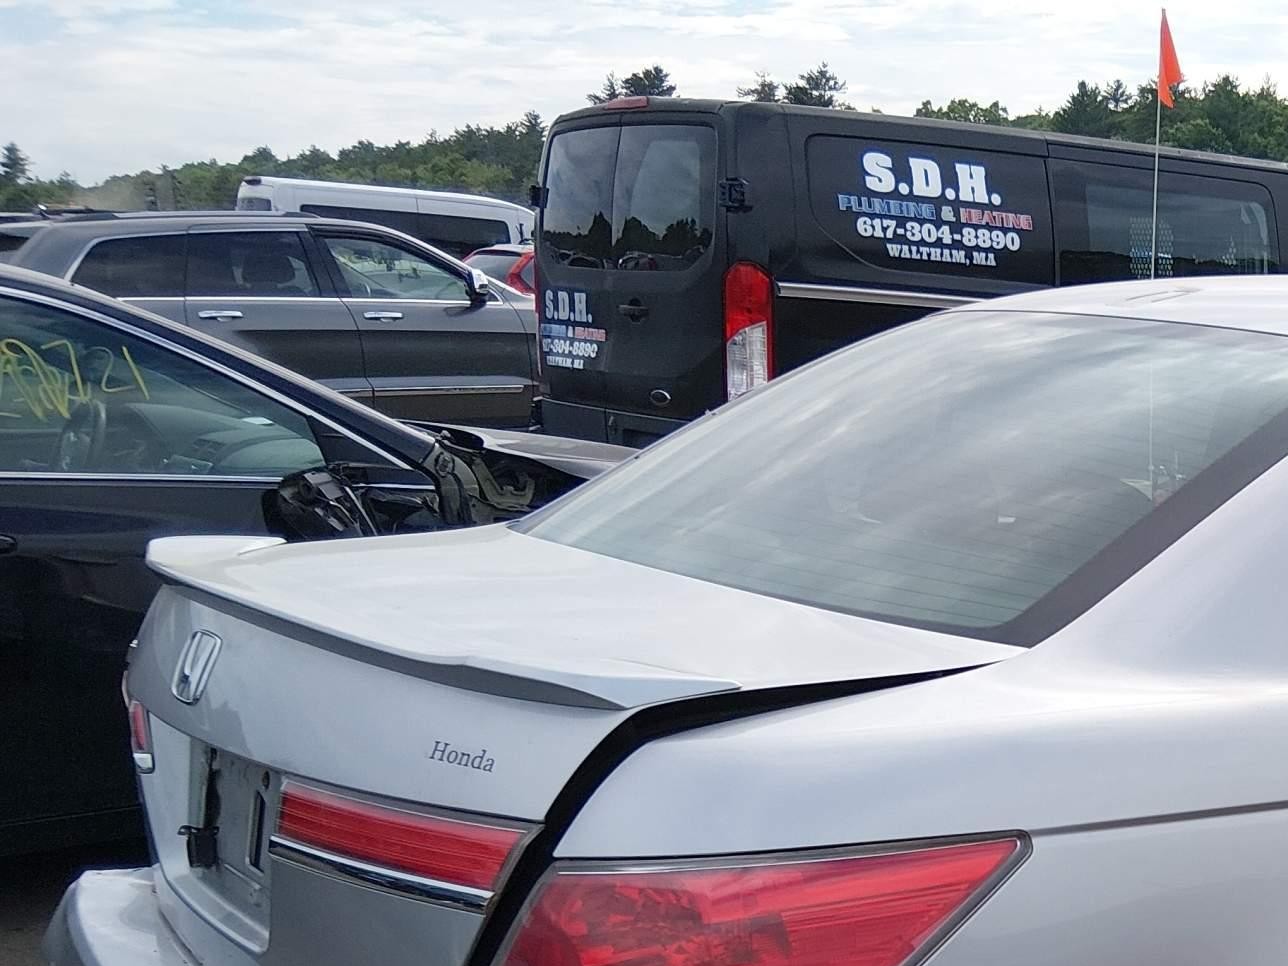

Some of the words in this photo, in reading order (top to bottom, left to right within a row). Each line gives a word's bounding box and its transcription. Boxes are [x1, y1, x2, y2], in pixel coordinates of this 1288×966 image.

[862, 152, 1002, 206] S.D.H.
[837, 194, 936, 220] PLUMBING
[940, 205, 956, 222] &
[959, 207, 1034, 231] HEATING
[856, 216, 1021, 251] 617-304-8890
[886, 243, 971, 266] WALTHAM,
[973, 251, 997, 267] MA
[545, 289, 593, 324] S.D.H.
[428, 740, 495, 773] Honda
